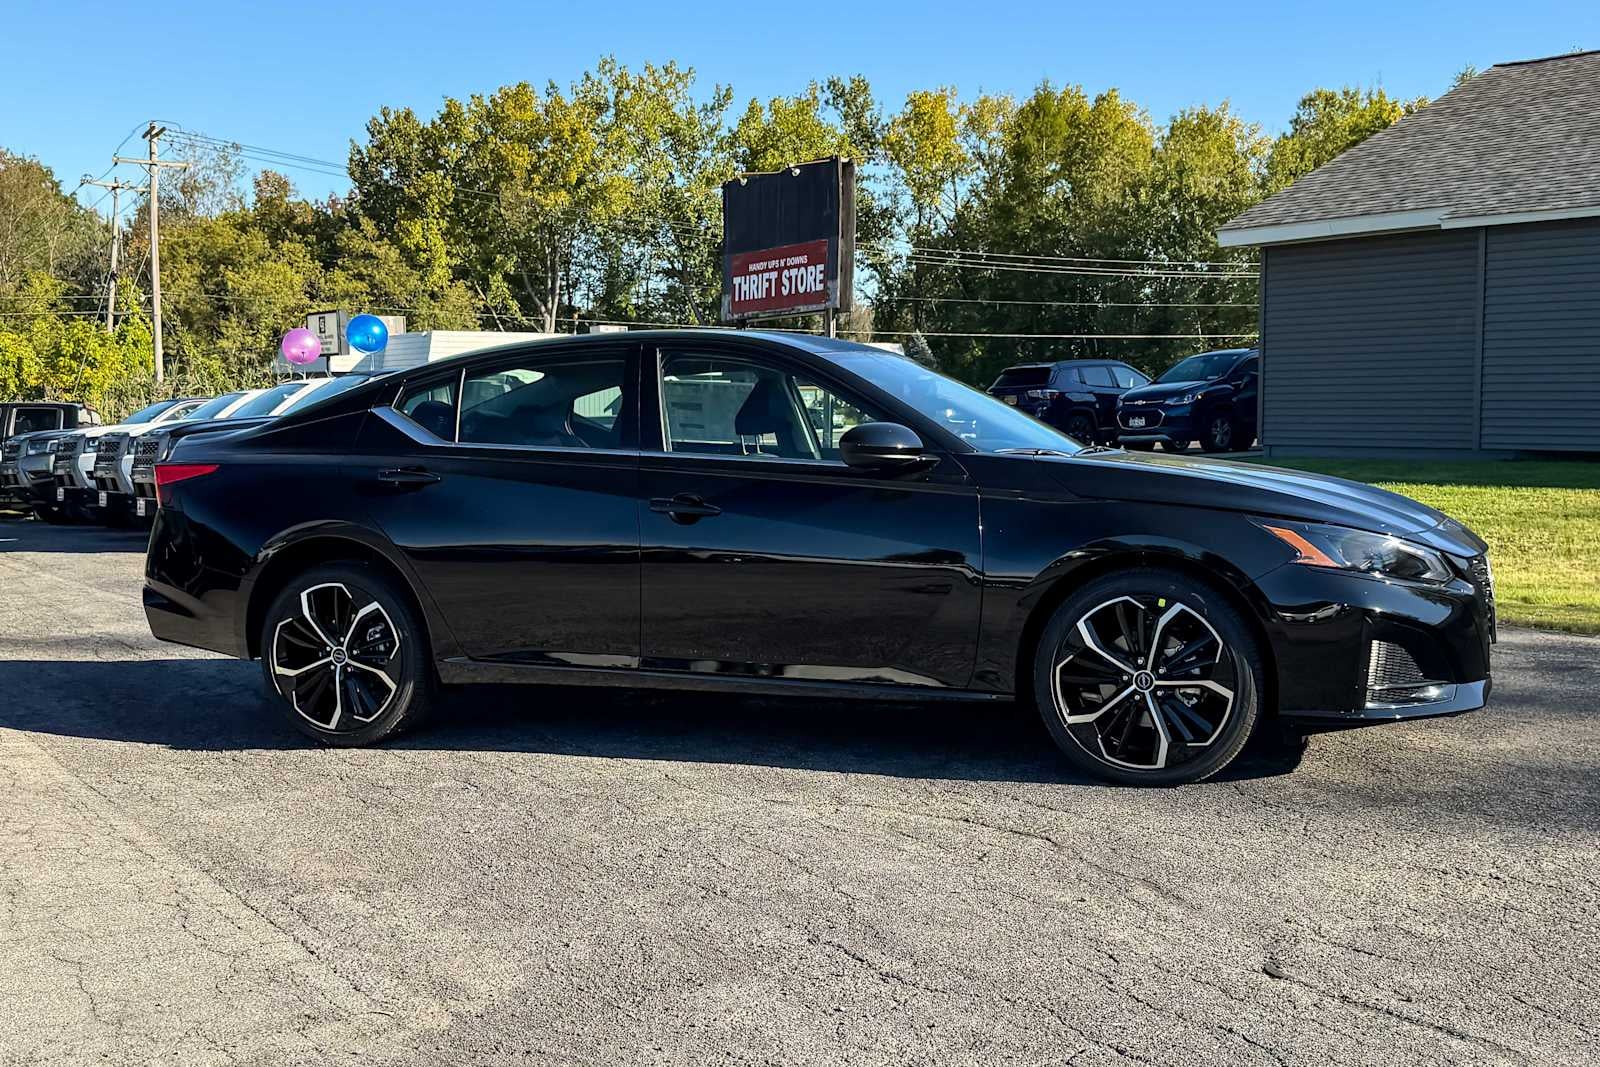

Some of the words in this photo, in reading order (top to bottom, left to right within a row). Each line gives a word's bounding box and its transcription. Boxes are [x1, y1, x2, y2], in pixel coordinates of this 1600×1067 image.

[748, 261, 768, 272] HANDY
[768, 259, 780, 269] UPS
[786, 254, 808, 266] DOWNS
[733, 271, 778, 302] THRIFT
[781, 264, 825, 296] STORE
